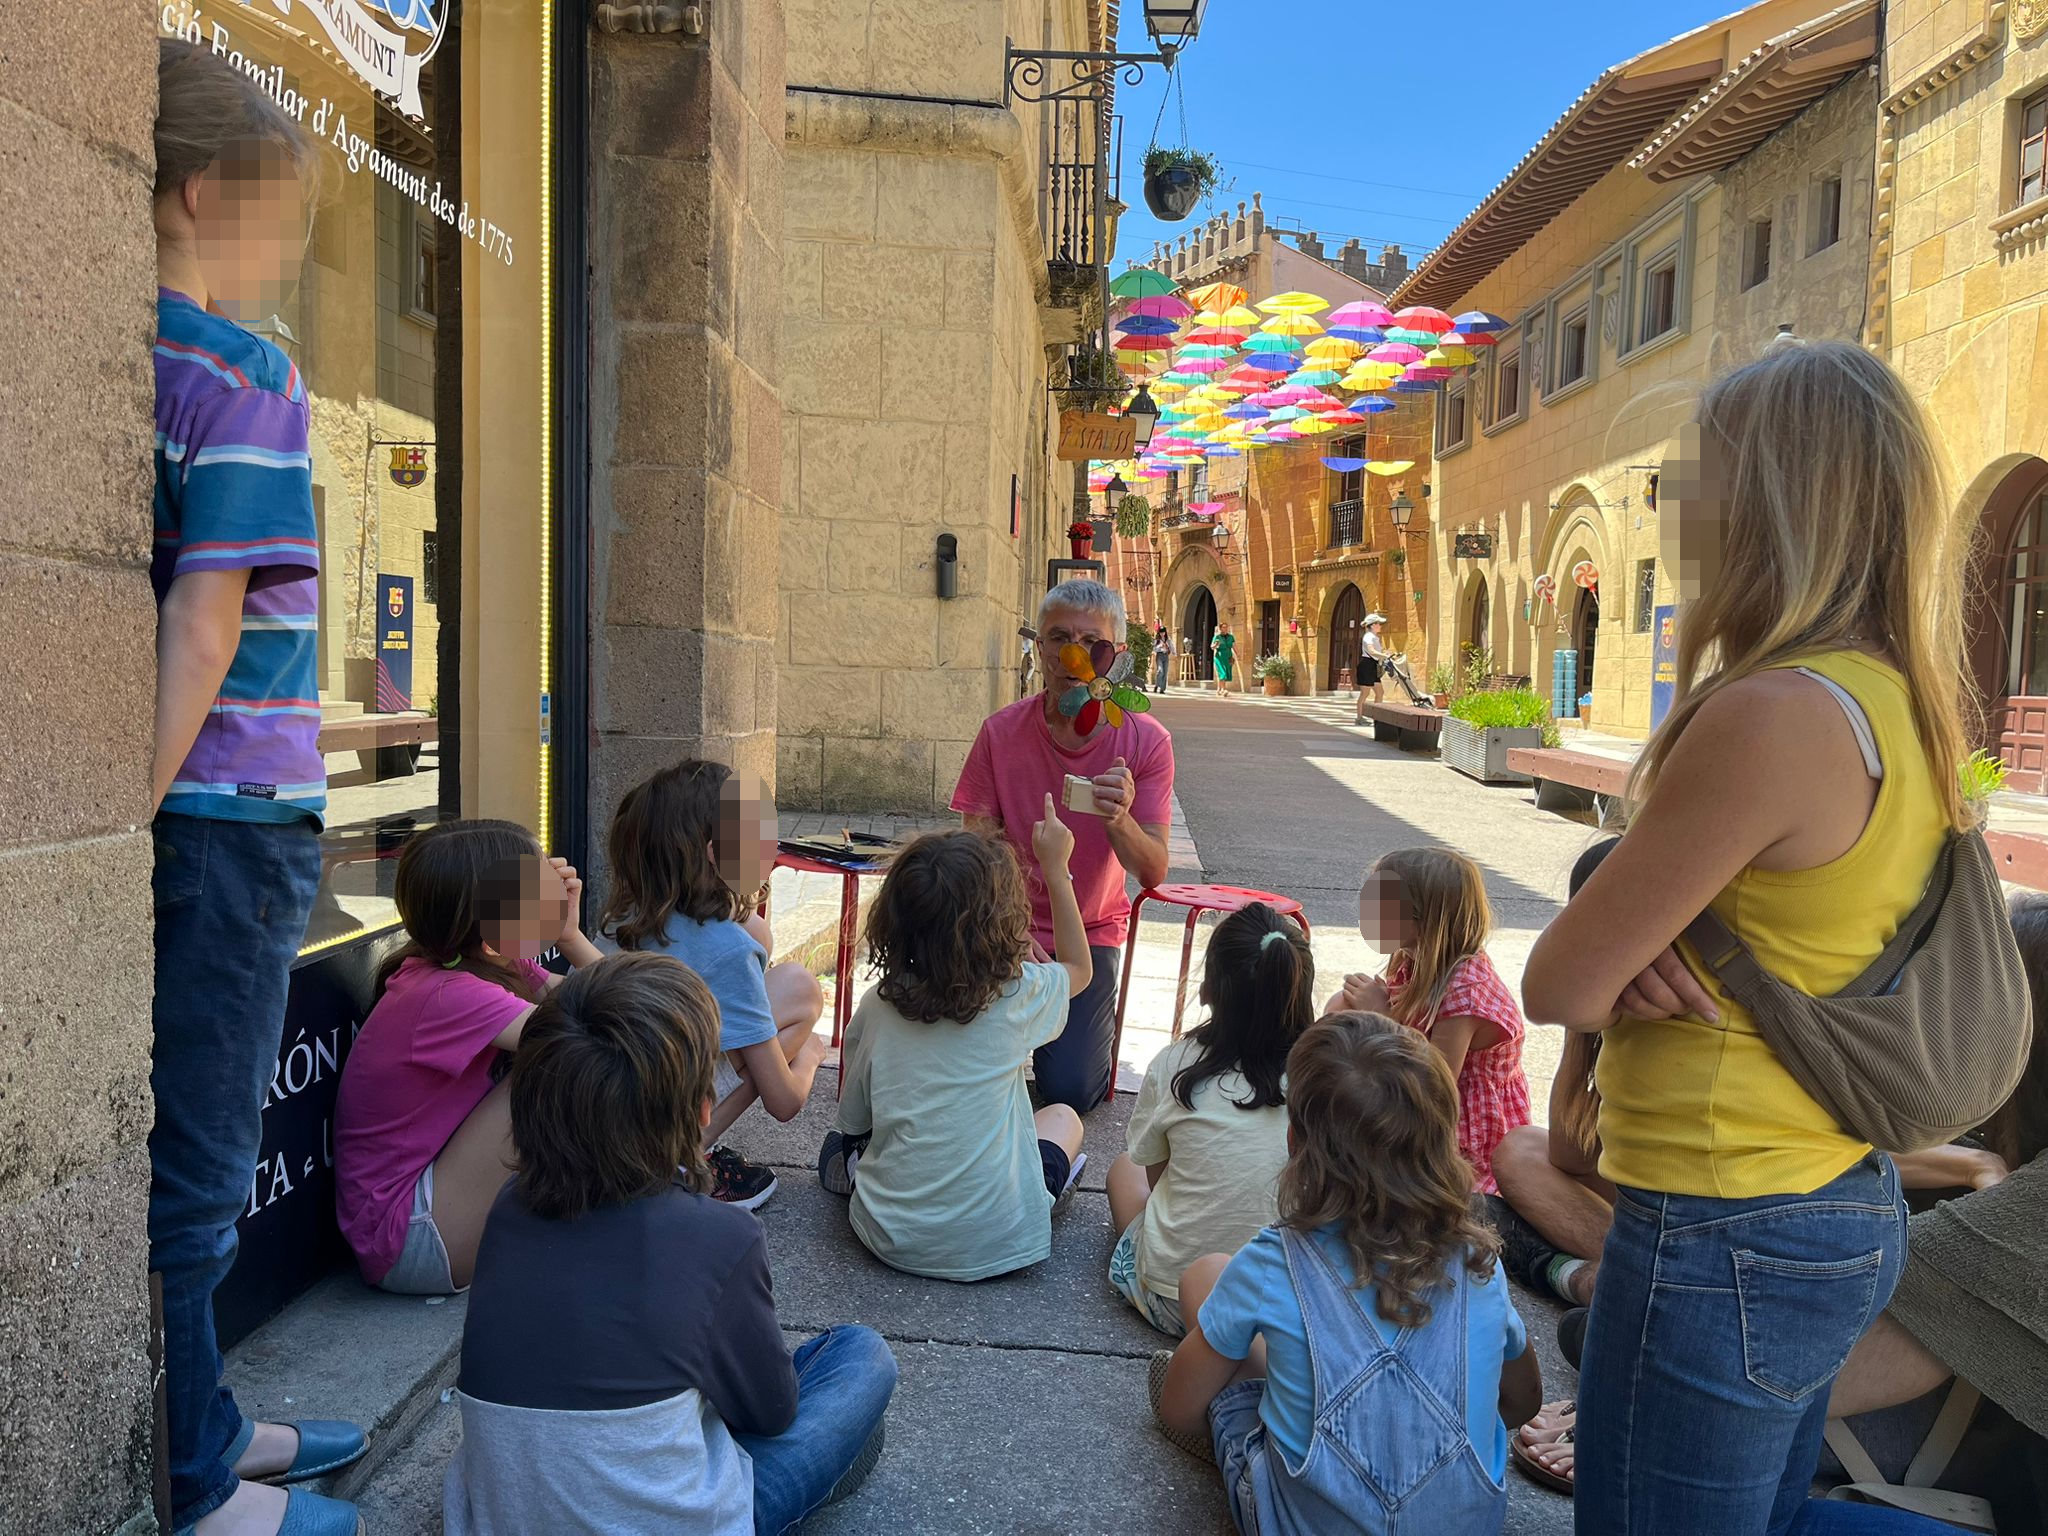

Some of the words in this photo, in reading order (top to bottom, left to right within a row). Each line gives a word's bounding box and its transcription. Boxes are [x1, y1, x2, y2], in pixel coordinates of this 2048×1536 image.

[319, 0, 396, 77] RAMUNT
[430, 182, 455, 225] des
[458, 202, 475, 239] de
[479, 218, 513, 266] 1775
